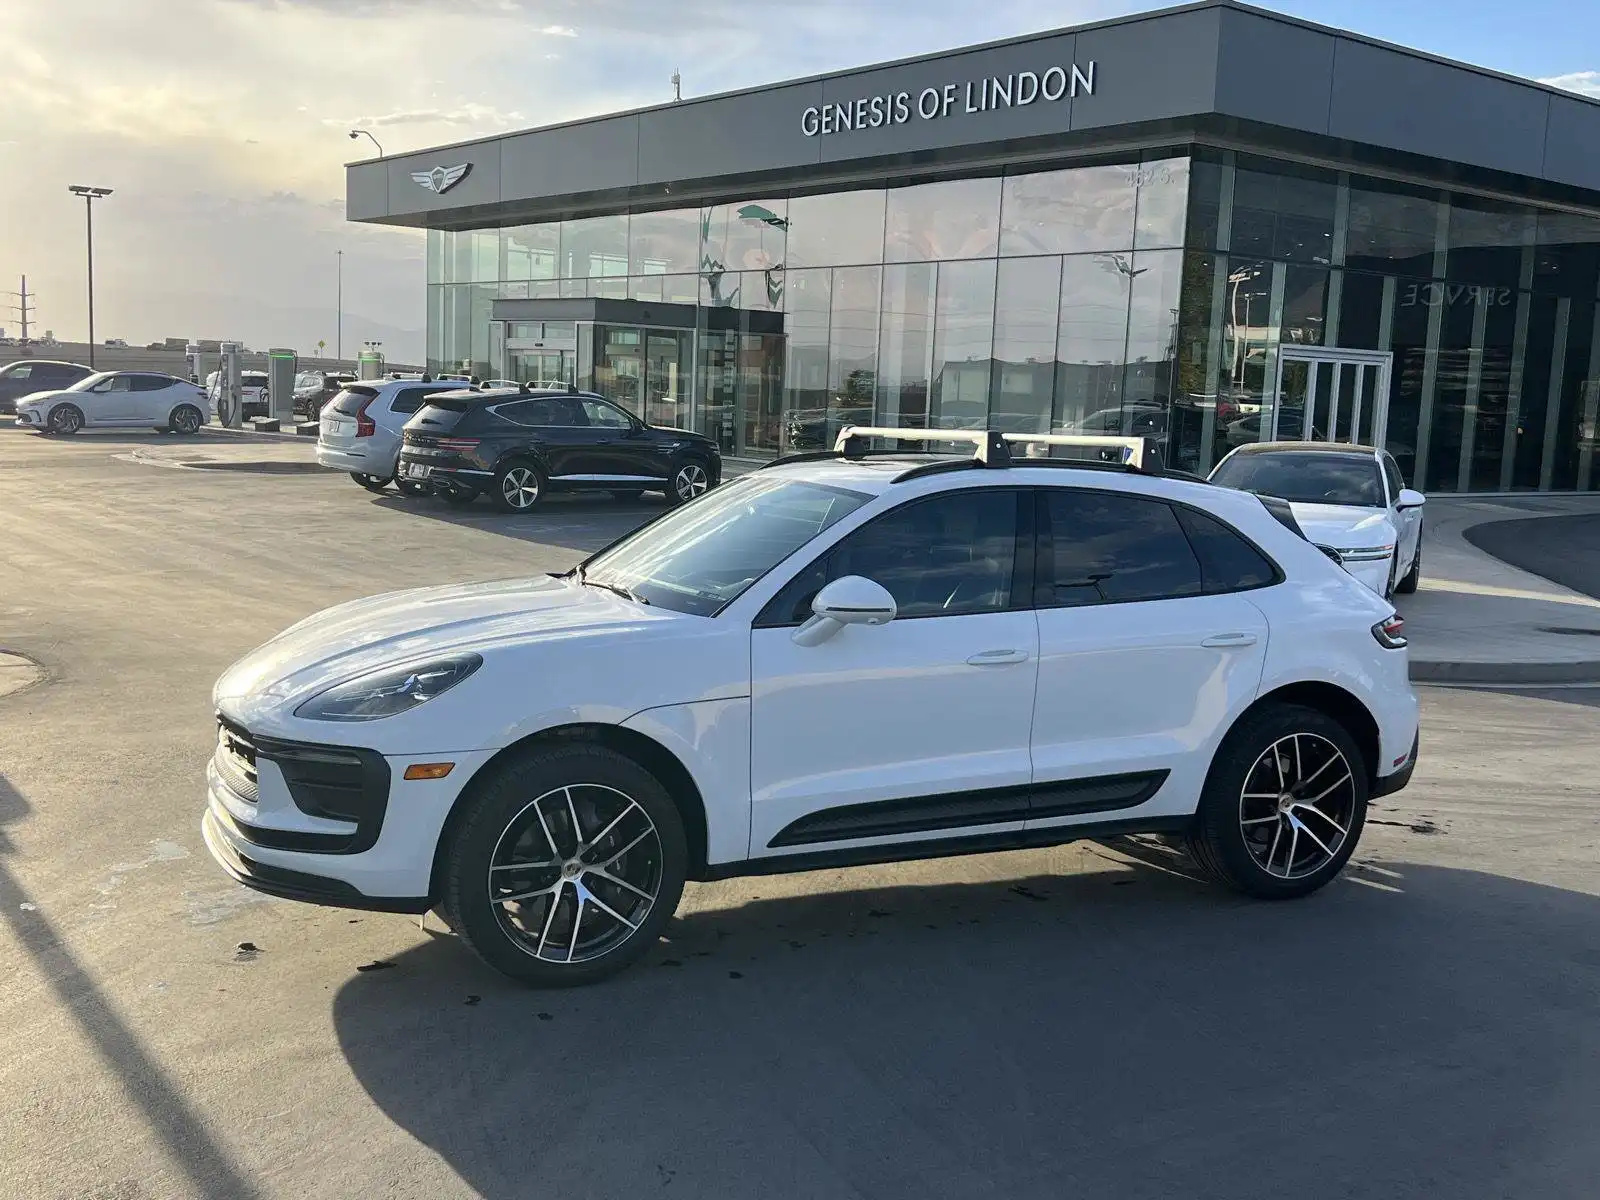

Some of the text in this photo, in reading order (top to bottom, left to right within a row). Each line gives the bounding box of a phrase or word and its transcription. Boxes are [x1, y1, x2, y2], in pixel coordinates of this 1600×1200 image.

[801, 61, 1097, 137] GENESIS OF LINDON
